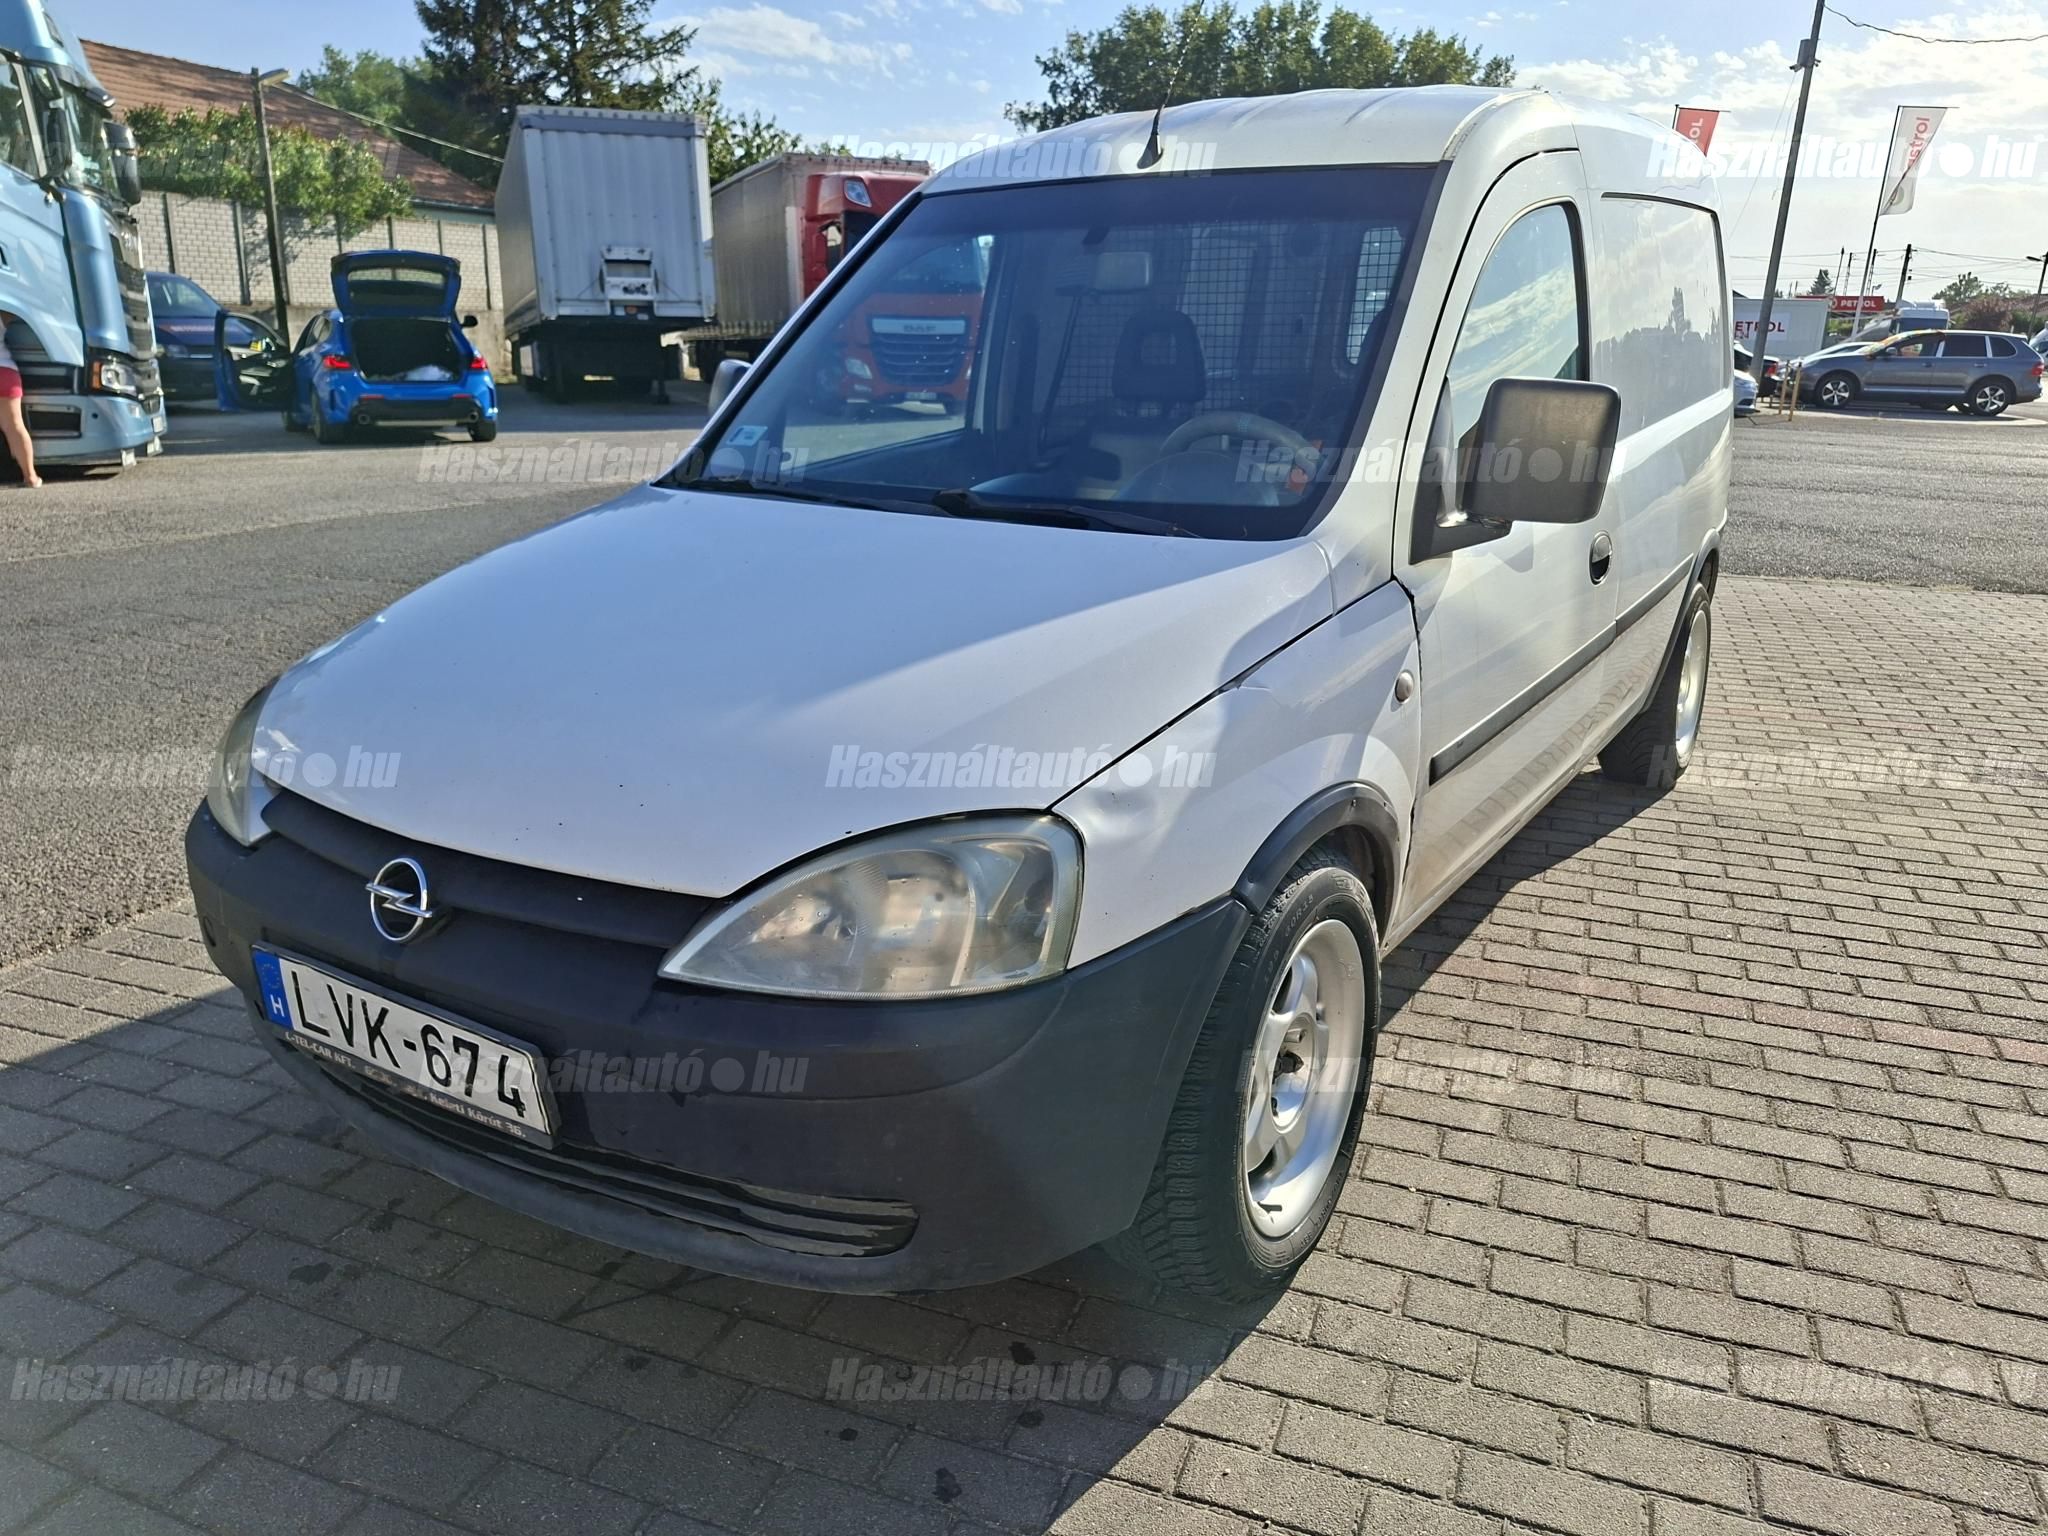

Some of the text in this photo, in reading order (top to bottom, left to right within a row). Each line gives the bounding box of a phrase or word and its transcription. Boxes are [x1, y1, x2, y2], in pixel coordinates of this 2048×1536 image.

[1840, 300, 1877, 308] PETOL
[1734, 321, 1785, 332] ETOL
[269, 993, 286, 1018] H
[291, 970, 525, 1119] LVK-674
